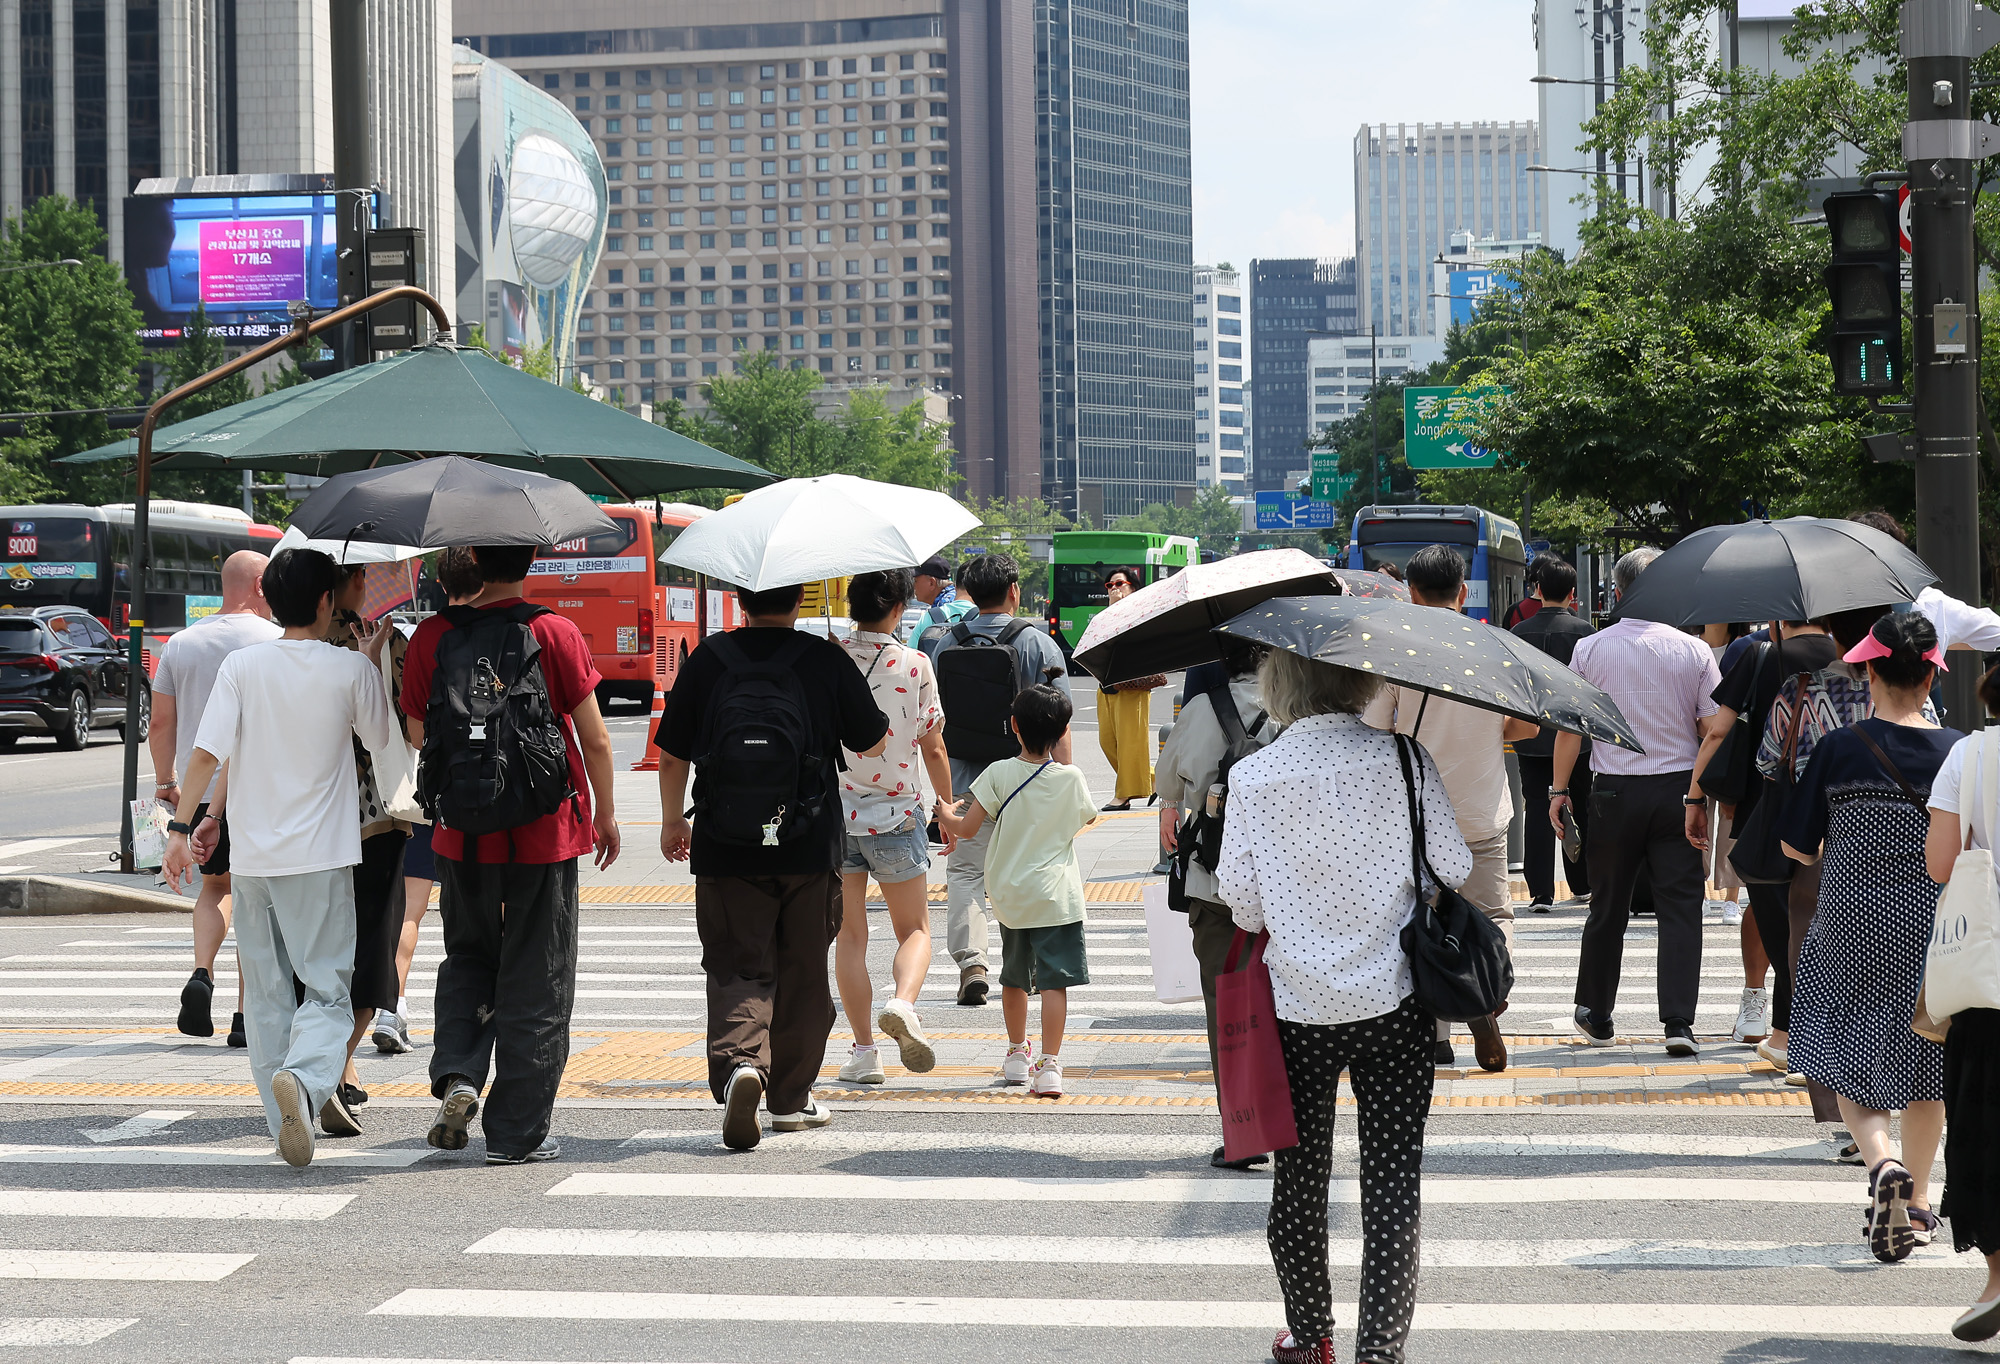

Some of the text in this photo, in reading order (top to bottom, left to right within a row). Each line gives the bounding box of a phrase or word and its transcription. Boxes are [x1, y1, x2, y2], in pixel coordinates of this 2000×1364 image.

[225, 228, 283, 239] 부산시 주요
[249, 239, 260, 250] 및
[233, 252, 272, 265] 17개소
[9, 538, 36, 554] 9000
[548, 562, 575, 573] 관리는
[576, 560, 630, 571] 신한은행에서
[557, 600, 584, 608] 동성교통
